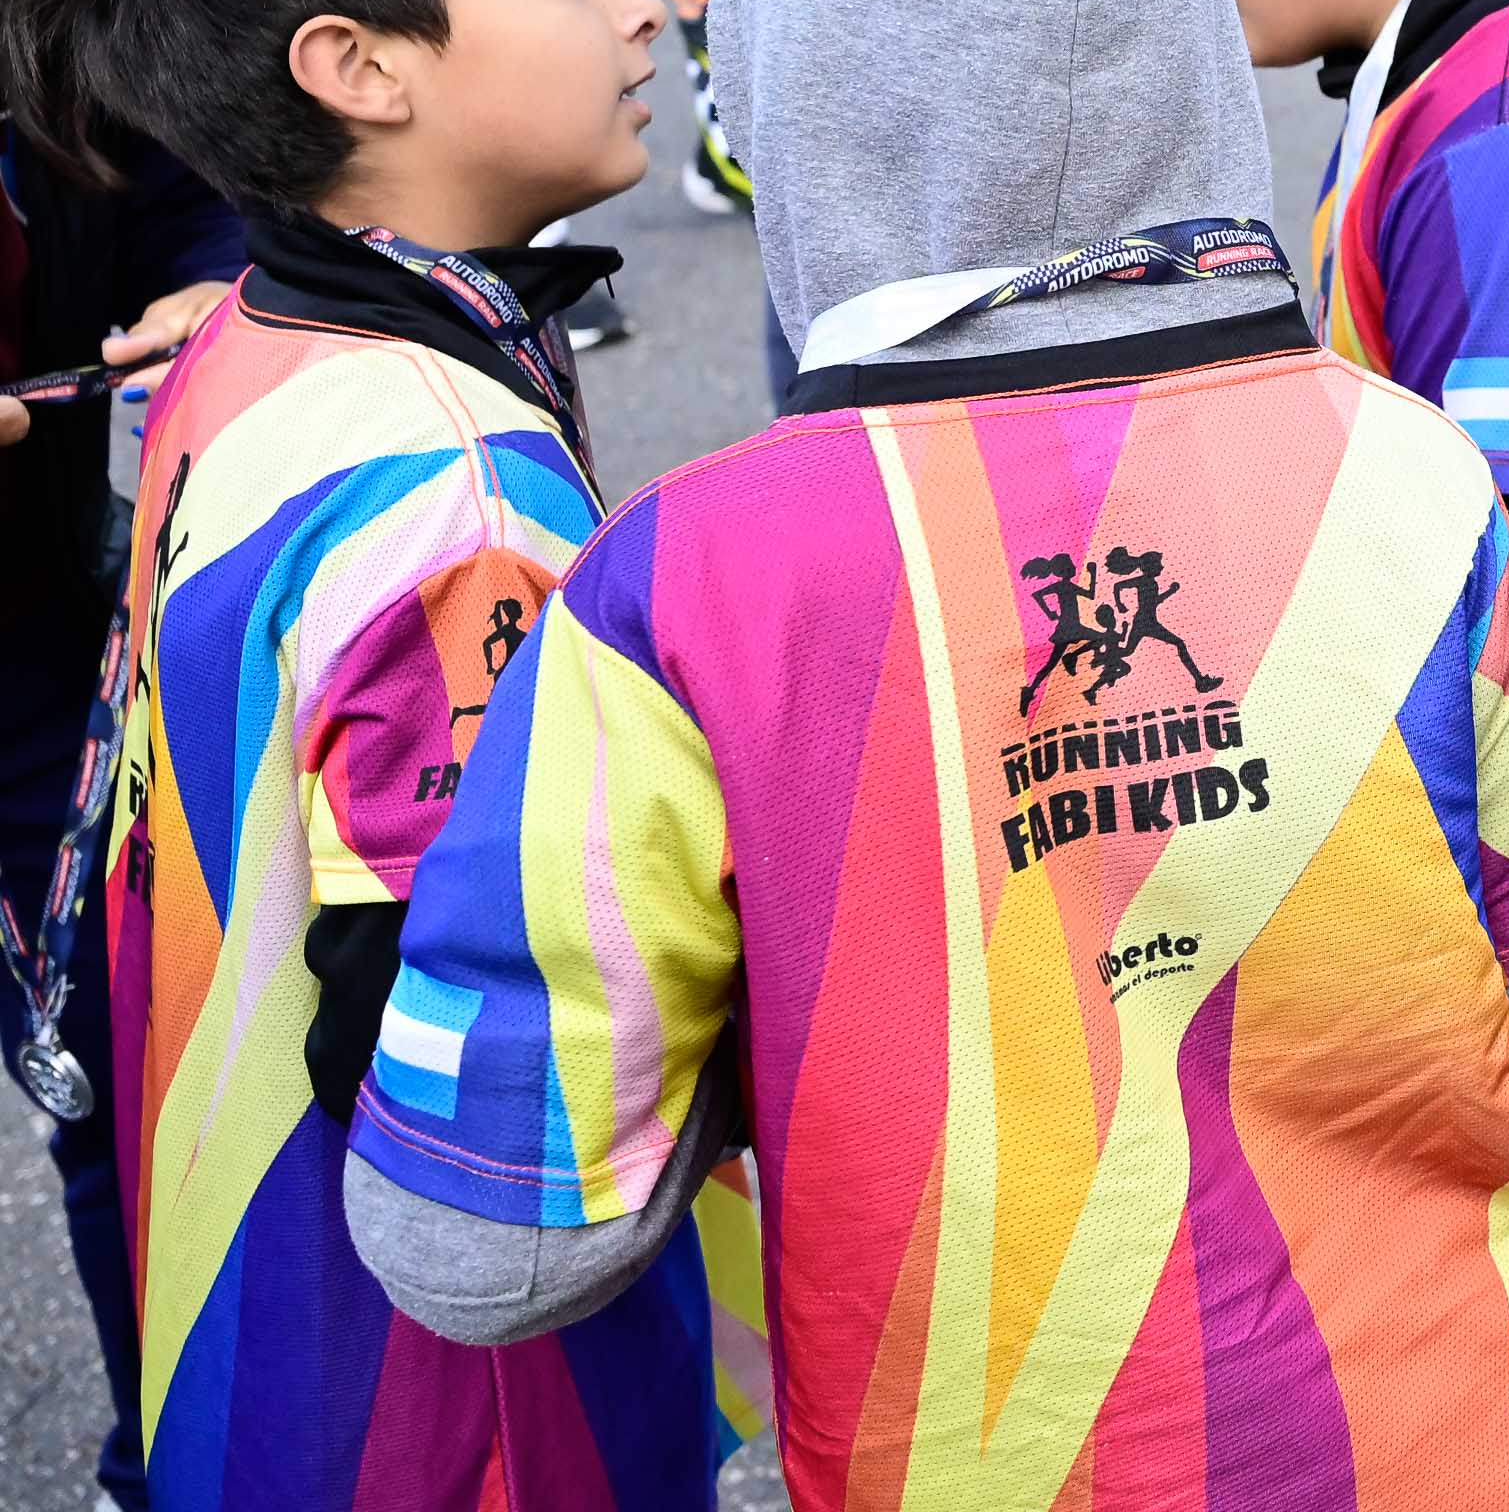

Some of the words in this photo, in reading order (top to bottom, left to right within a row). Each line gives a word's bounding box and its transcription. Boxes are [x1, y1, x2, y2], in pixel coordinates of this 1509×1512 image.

[1193, 226, 1272, 254] AUTÓDROMO
[1206, 248, 1249, 265] RUNNING
[1001, 700, 1243, 798] RUNNING
[1000, 785, 1117, 873] FABI
[1127, 758, 1271, 833] KIDS
[1132, 974, 1141, 986] el
[1144, 963, 1195, 981] deporte
